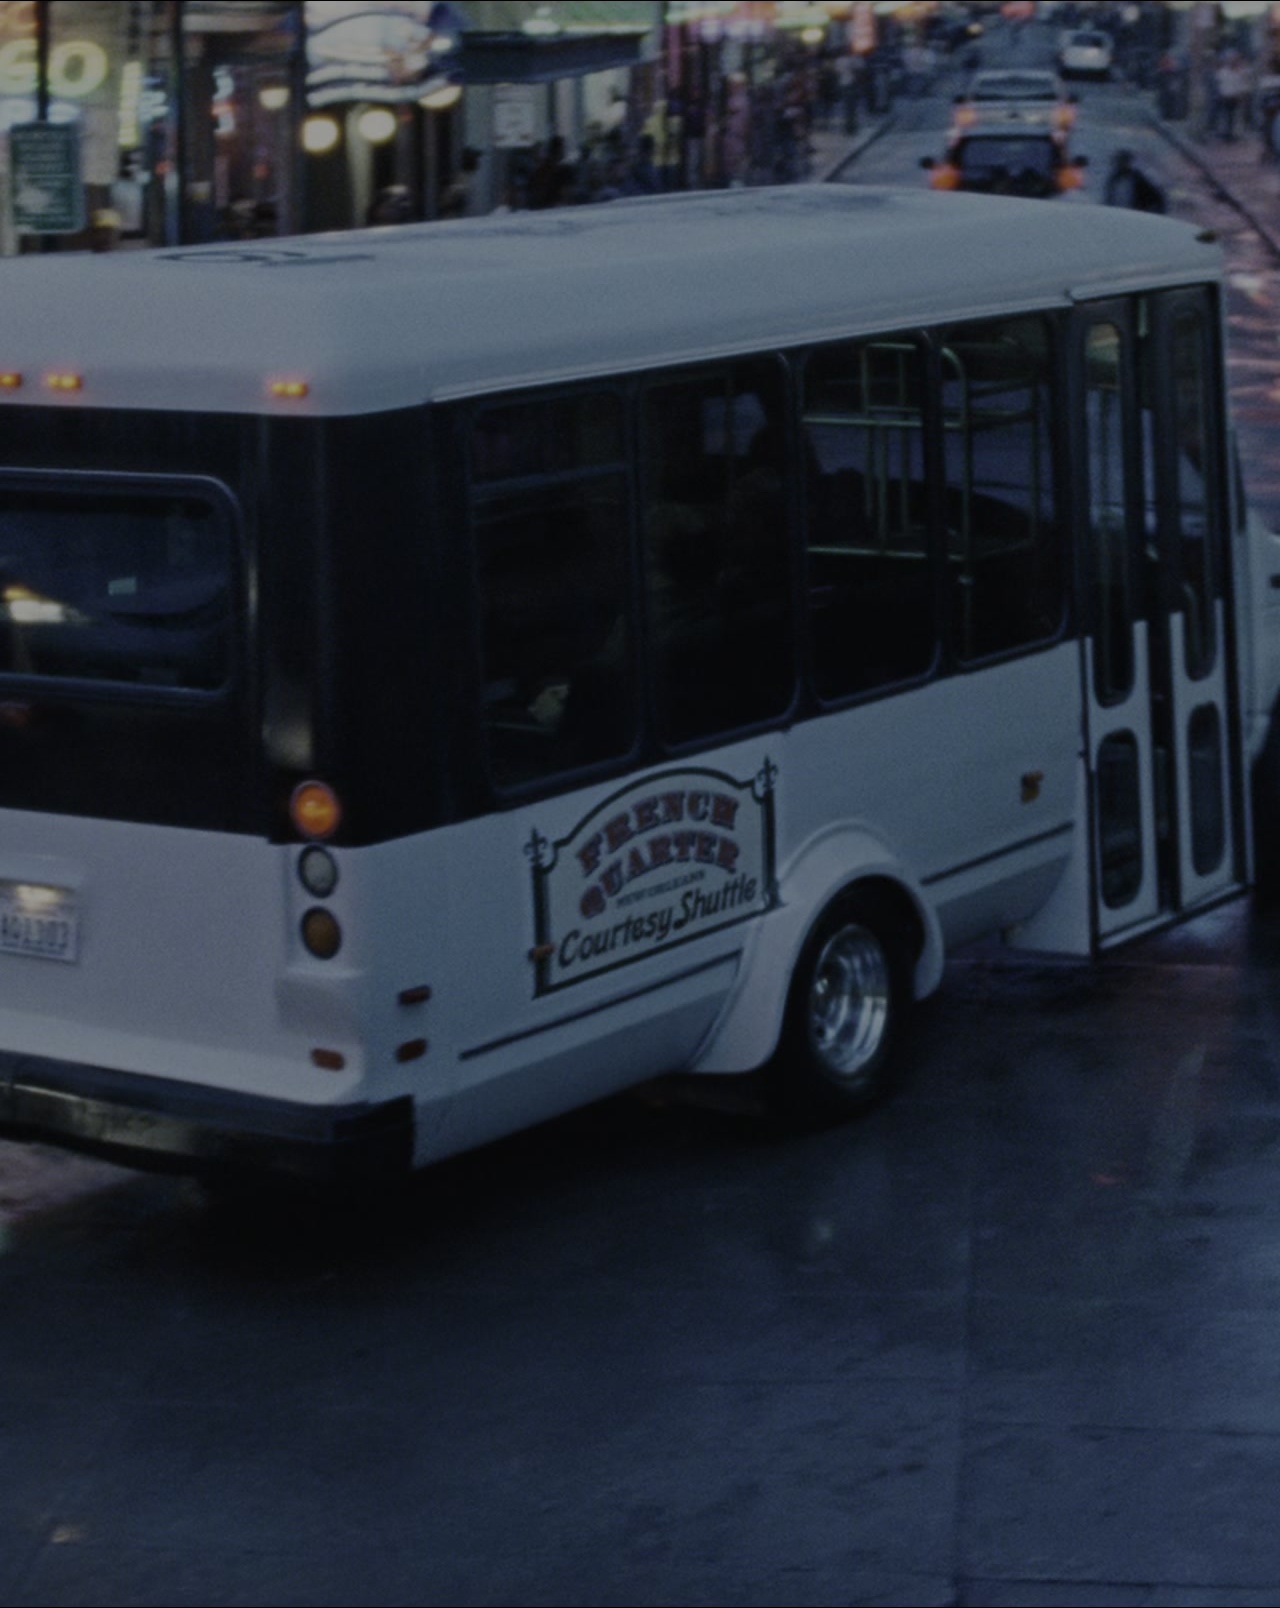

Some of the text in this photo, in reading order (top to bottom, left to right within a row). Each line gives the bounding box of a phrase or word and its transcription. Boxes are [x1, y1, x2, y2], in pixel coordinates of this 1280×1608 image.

[577, 789, 740, 878] FRENCH
[580, 829, 740, 919] QUARTER
[558, 873, 758, 967] Courtesy Shuttle
